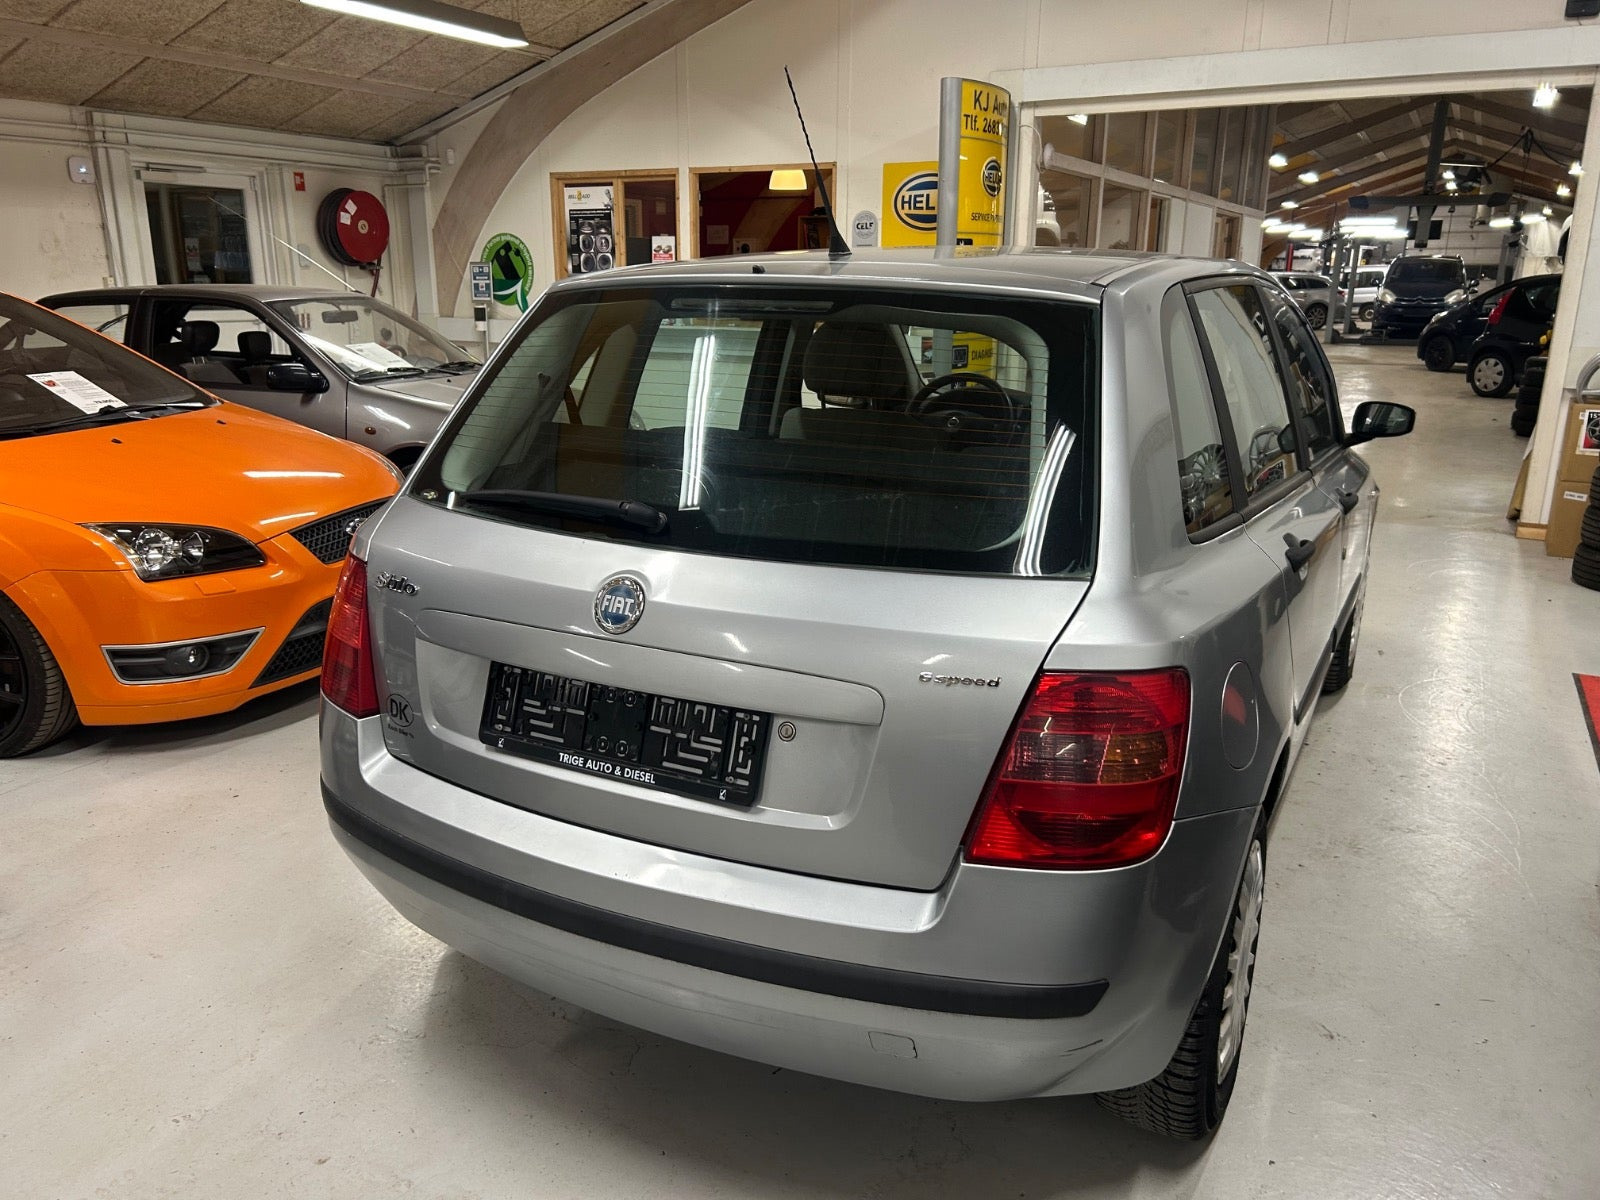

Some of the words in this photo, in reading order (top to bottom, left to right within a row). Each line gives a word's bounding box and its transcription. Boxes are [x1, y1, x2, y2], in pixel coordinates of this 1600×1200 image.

[973, 89, 990, 112] KJ
[992, 95, 1007, 116] Au
[963, 113, 979, 132] Tlf.
[982, 117, 1002, 136] 2683
[900, 193, 936, 211] HEL
[601, 594, 635, 616] FIAT
[390, 698, 410, 724] DK
[559, 752, 584, 767] TRIGE
[586, 759, 612, 774] AUTO
[614, 766, 621, 776] &
[624, 768, 656, 784] DIESEL
